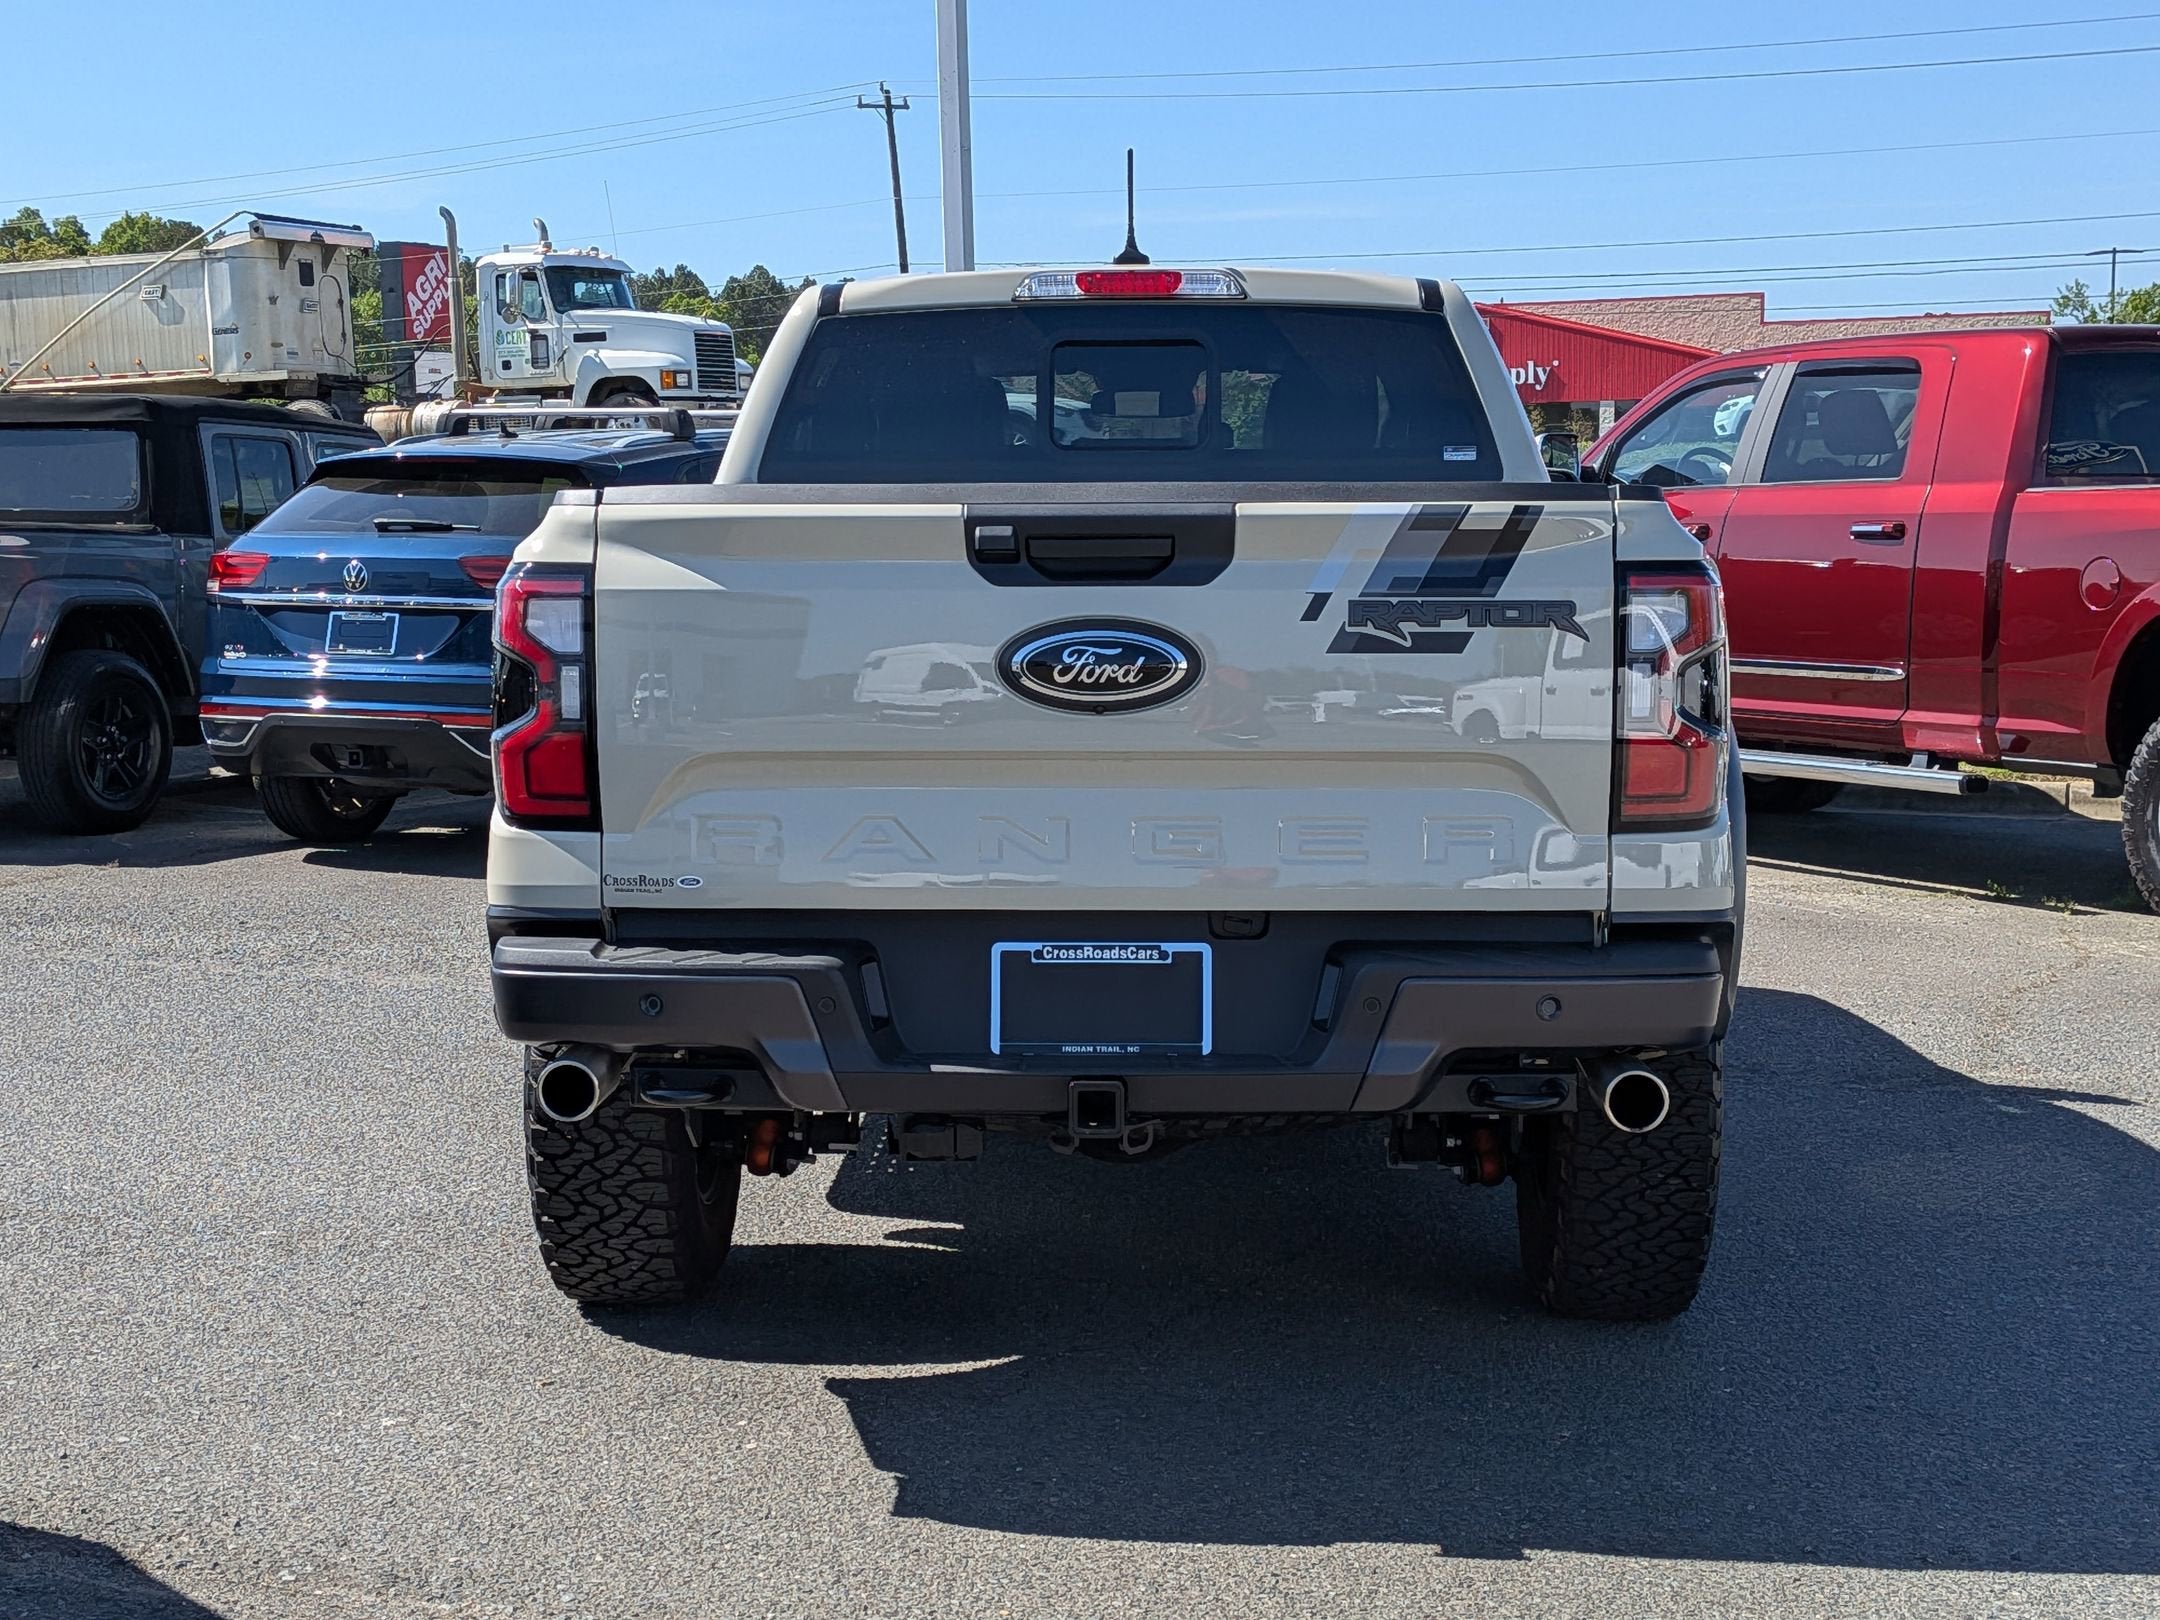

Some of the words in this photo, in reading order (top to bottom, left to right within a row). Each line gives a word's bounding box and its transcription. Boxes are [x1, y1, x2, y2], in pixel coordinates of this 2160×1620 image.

[406, 251, 447, 320] AGRI
[413, 276, 450, 340] SUPPL
[505, 330, 528, 345] CERT
[1348, 600, 1590, 642] RAPTOR
[1053, 645, 1146, 683] Ford
[690, 813, 1515, 866] RANGER
[1042, 946, 1160, 960] CrossRoadsCars
[1095, 1046, 1125, 1054] TRAIL,
